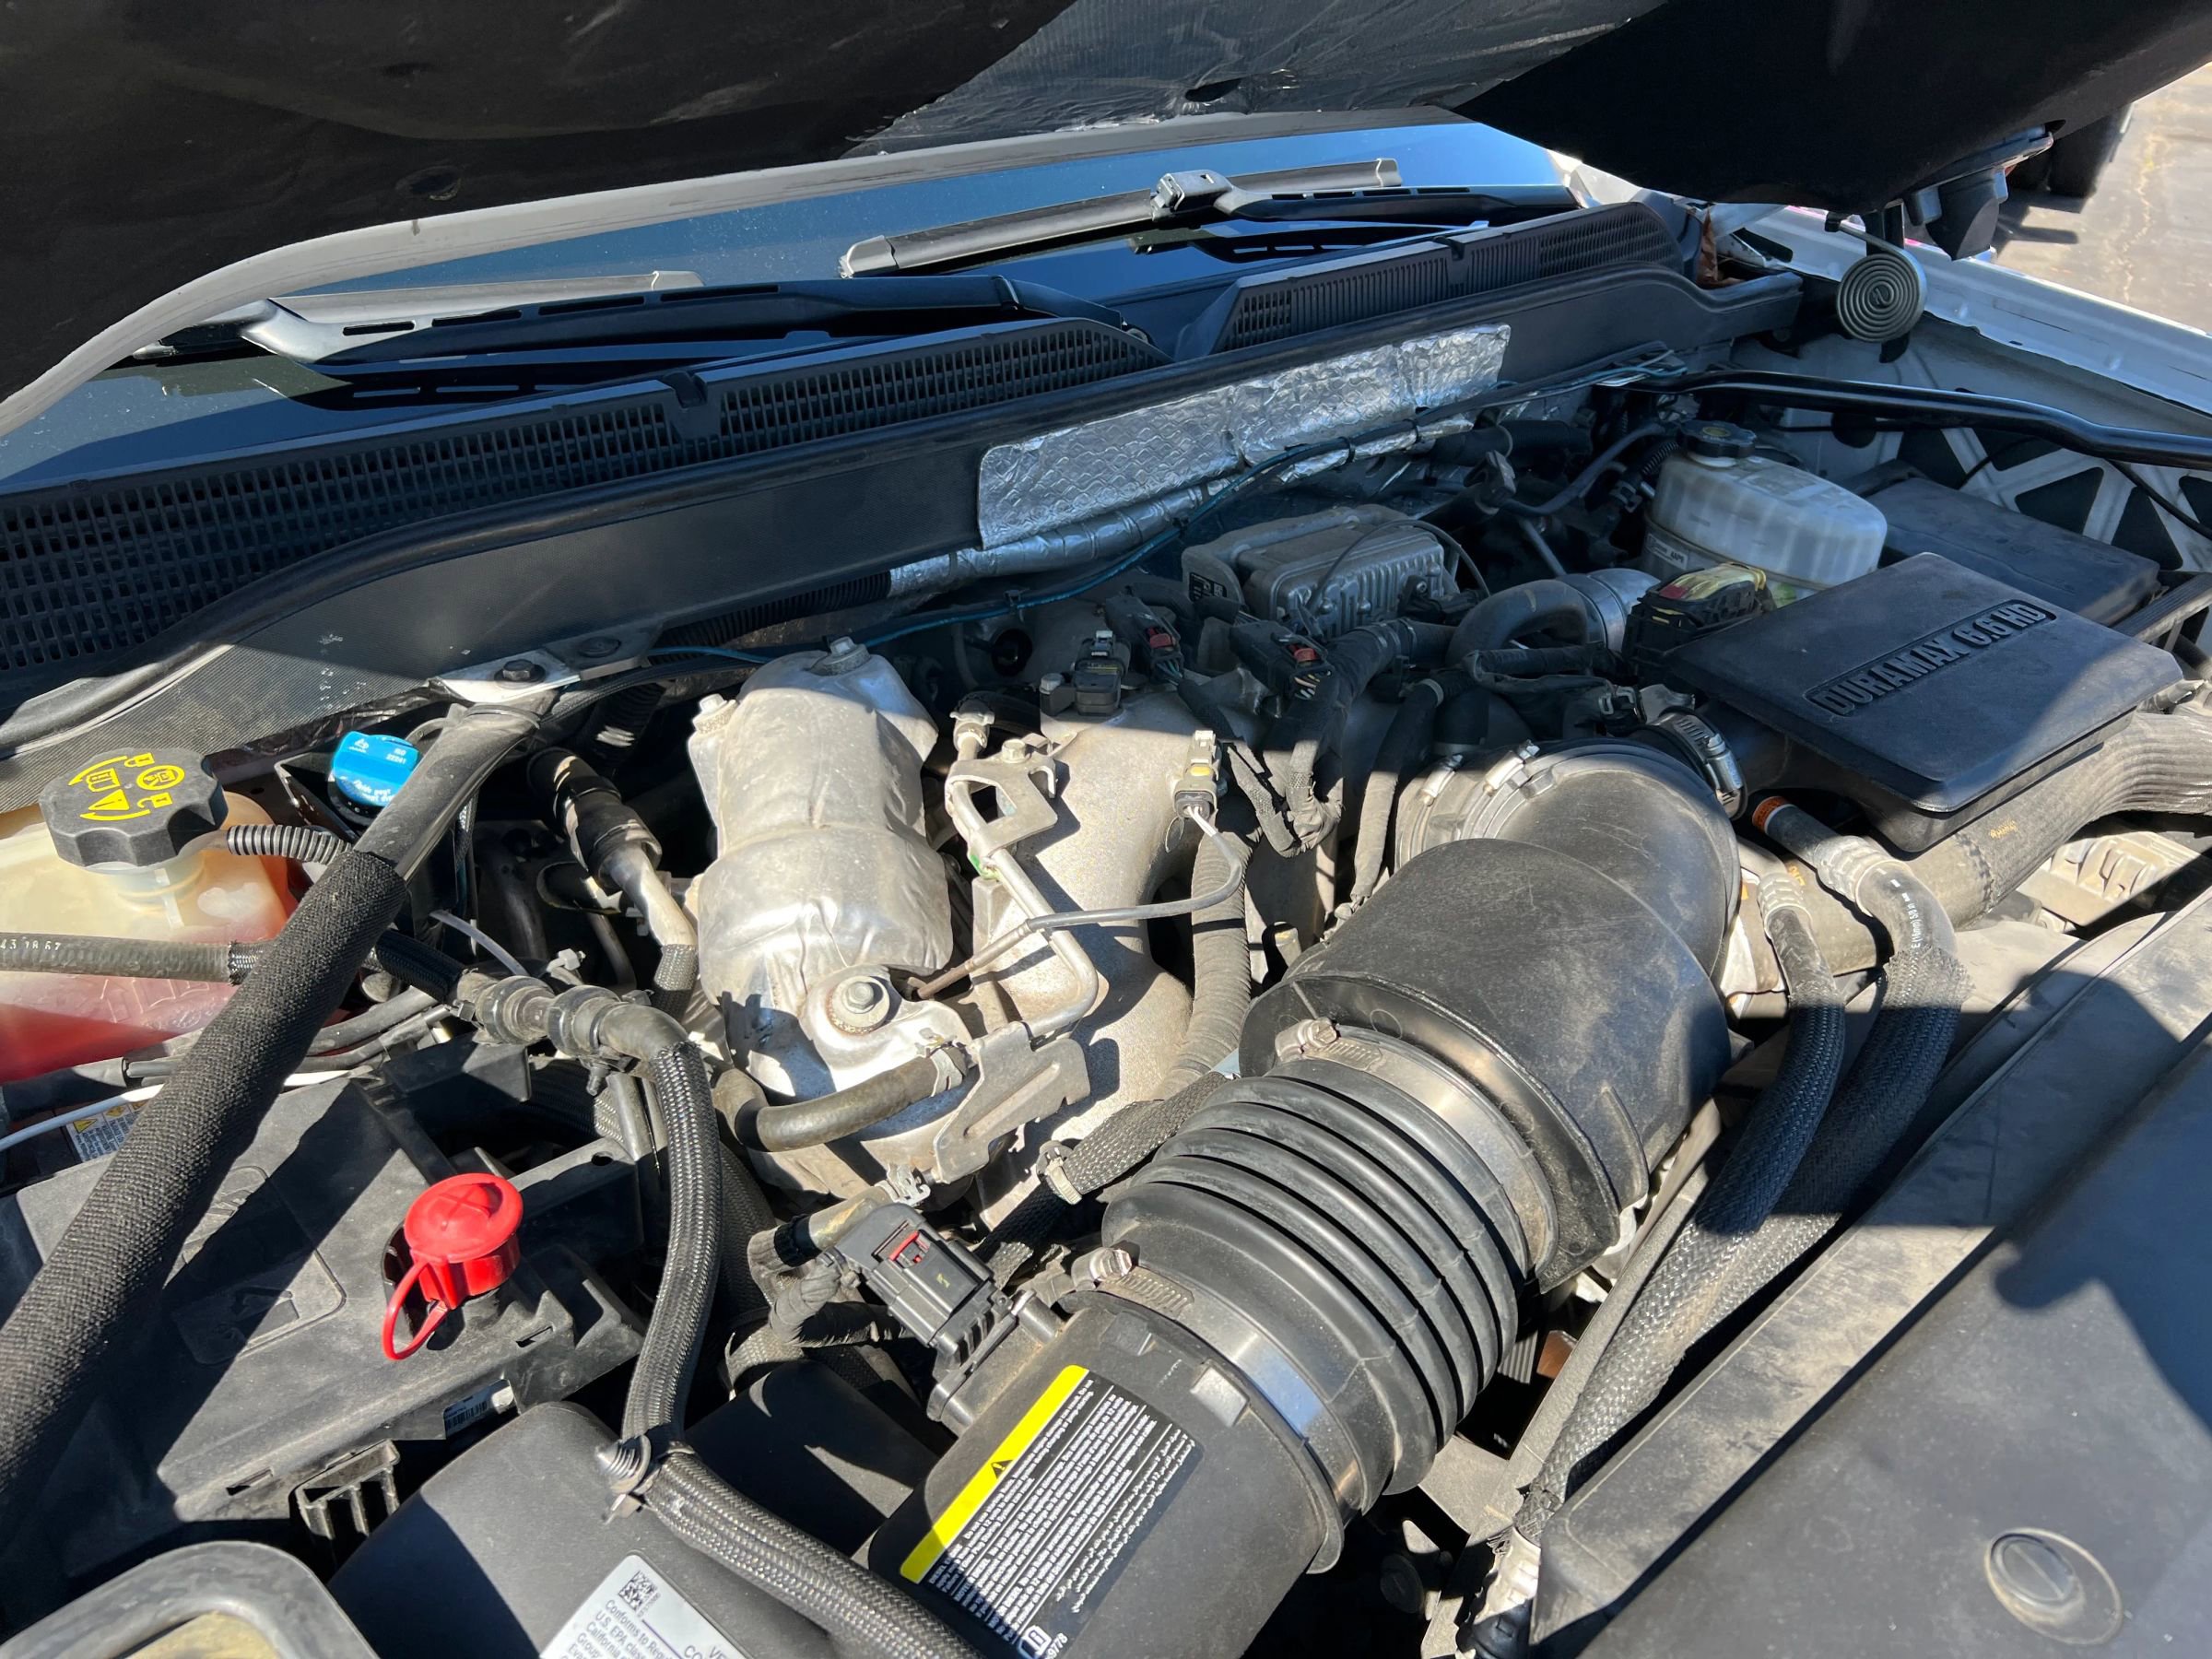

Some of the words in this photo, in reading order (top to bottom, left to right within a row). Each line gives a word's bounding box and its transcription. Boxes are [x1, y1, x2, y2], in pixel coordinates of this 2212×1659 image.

[1812, 637, 1971, 716] DURAMAX
[1952, 617, 2013, 646] 6.6
[1989, 602, 2048, 630] HD
[606, 1599, 641, 1637] Conforms
[609, 1625, 629, 1645] EPA
[586, 1621, 622, 1658] California
